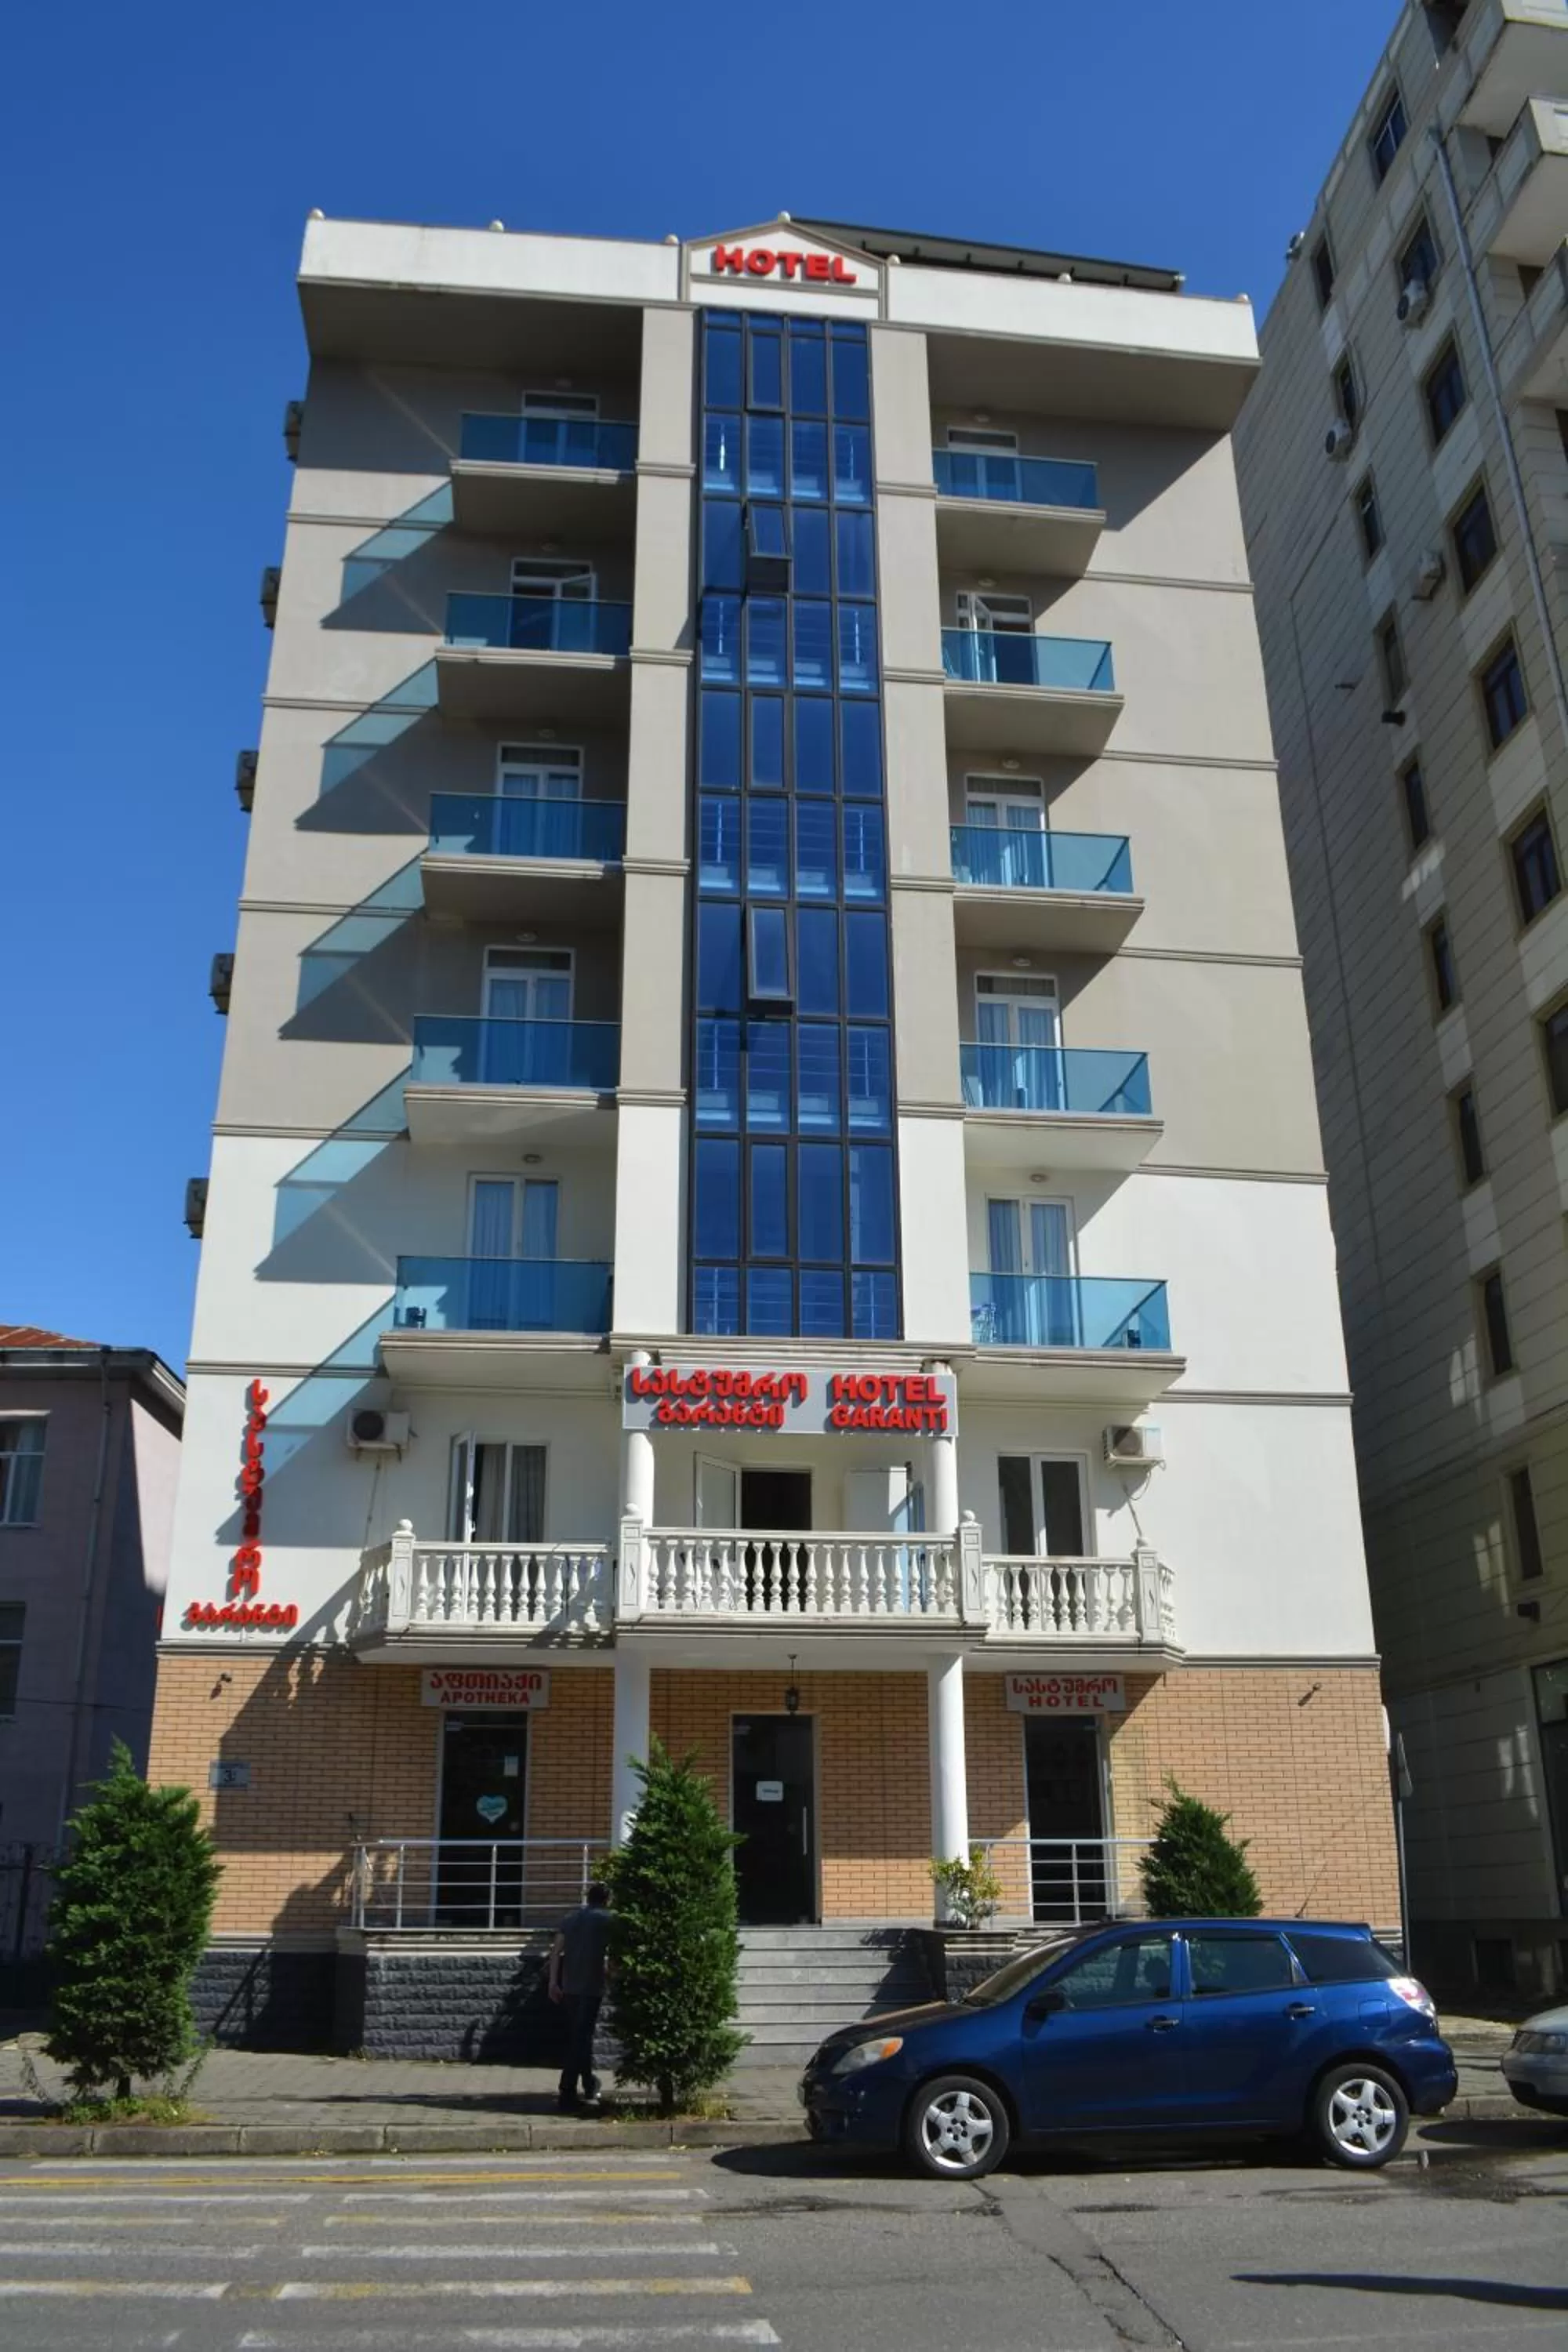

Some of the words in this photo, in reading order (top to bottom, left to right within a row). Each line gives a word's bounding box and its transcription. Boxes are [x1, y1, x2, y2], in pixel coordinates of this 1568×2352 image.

[714, 244, 857, 285] HOTEL
[631, 1367, 808, 1400] სასტუმრო
[833, 1374, 947, 1403] HOTEL
[657, 1398, 784, 1428] გარანტი
[832, 1404, 948, 1431] GARANTI
[430, 1671, 543, 1691] აფთიაქი
[1012, 1677, 1118, 1694] სასტუმრო
[440, 1690, 531, 1705] APOTHEKA
[1028, 1695, 1105, 1708] HOTEL
